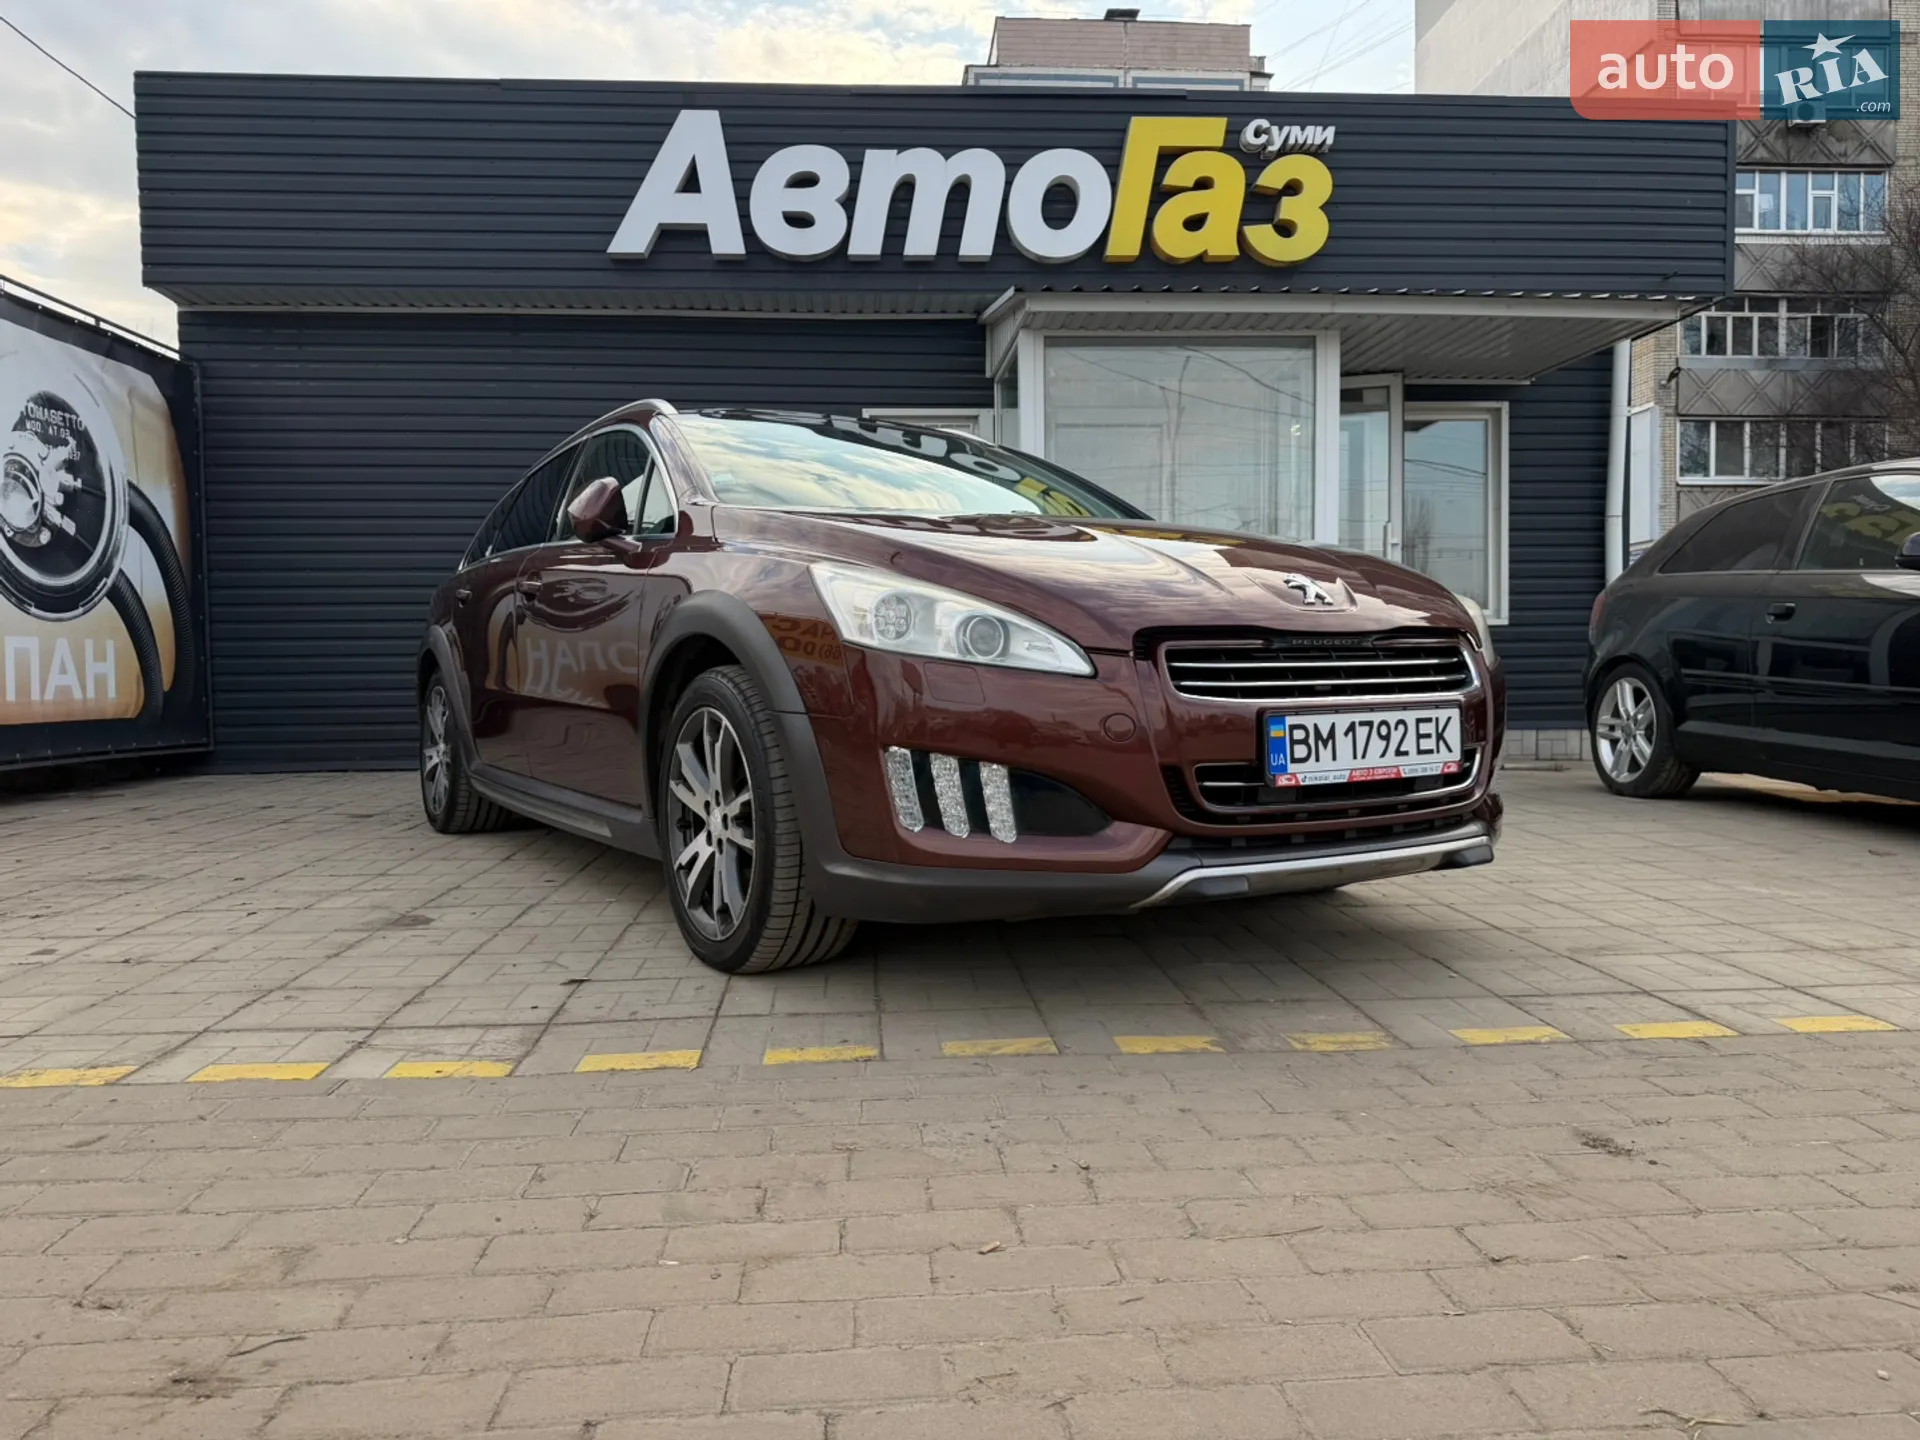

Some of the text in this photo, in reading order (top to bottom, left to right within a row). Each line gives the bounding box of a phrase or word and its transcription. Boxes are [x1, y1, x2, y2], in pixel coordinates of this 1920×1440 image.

[1243, 118, 1336, 155] Суми
[4, 635, 117, 702] ПАН
[1270, 754, 1286, 766] UA
[1288, 716, 1453, 764] BM 1792 EK
